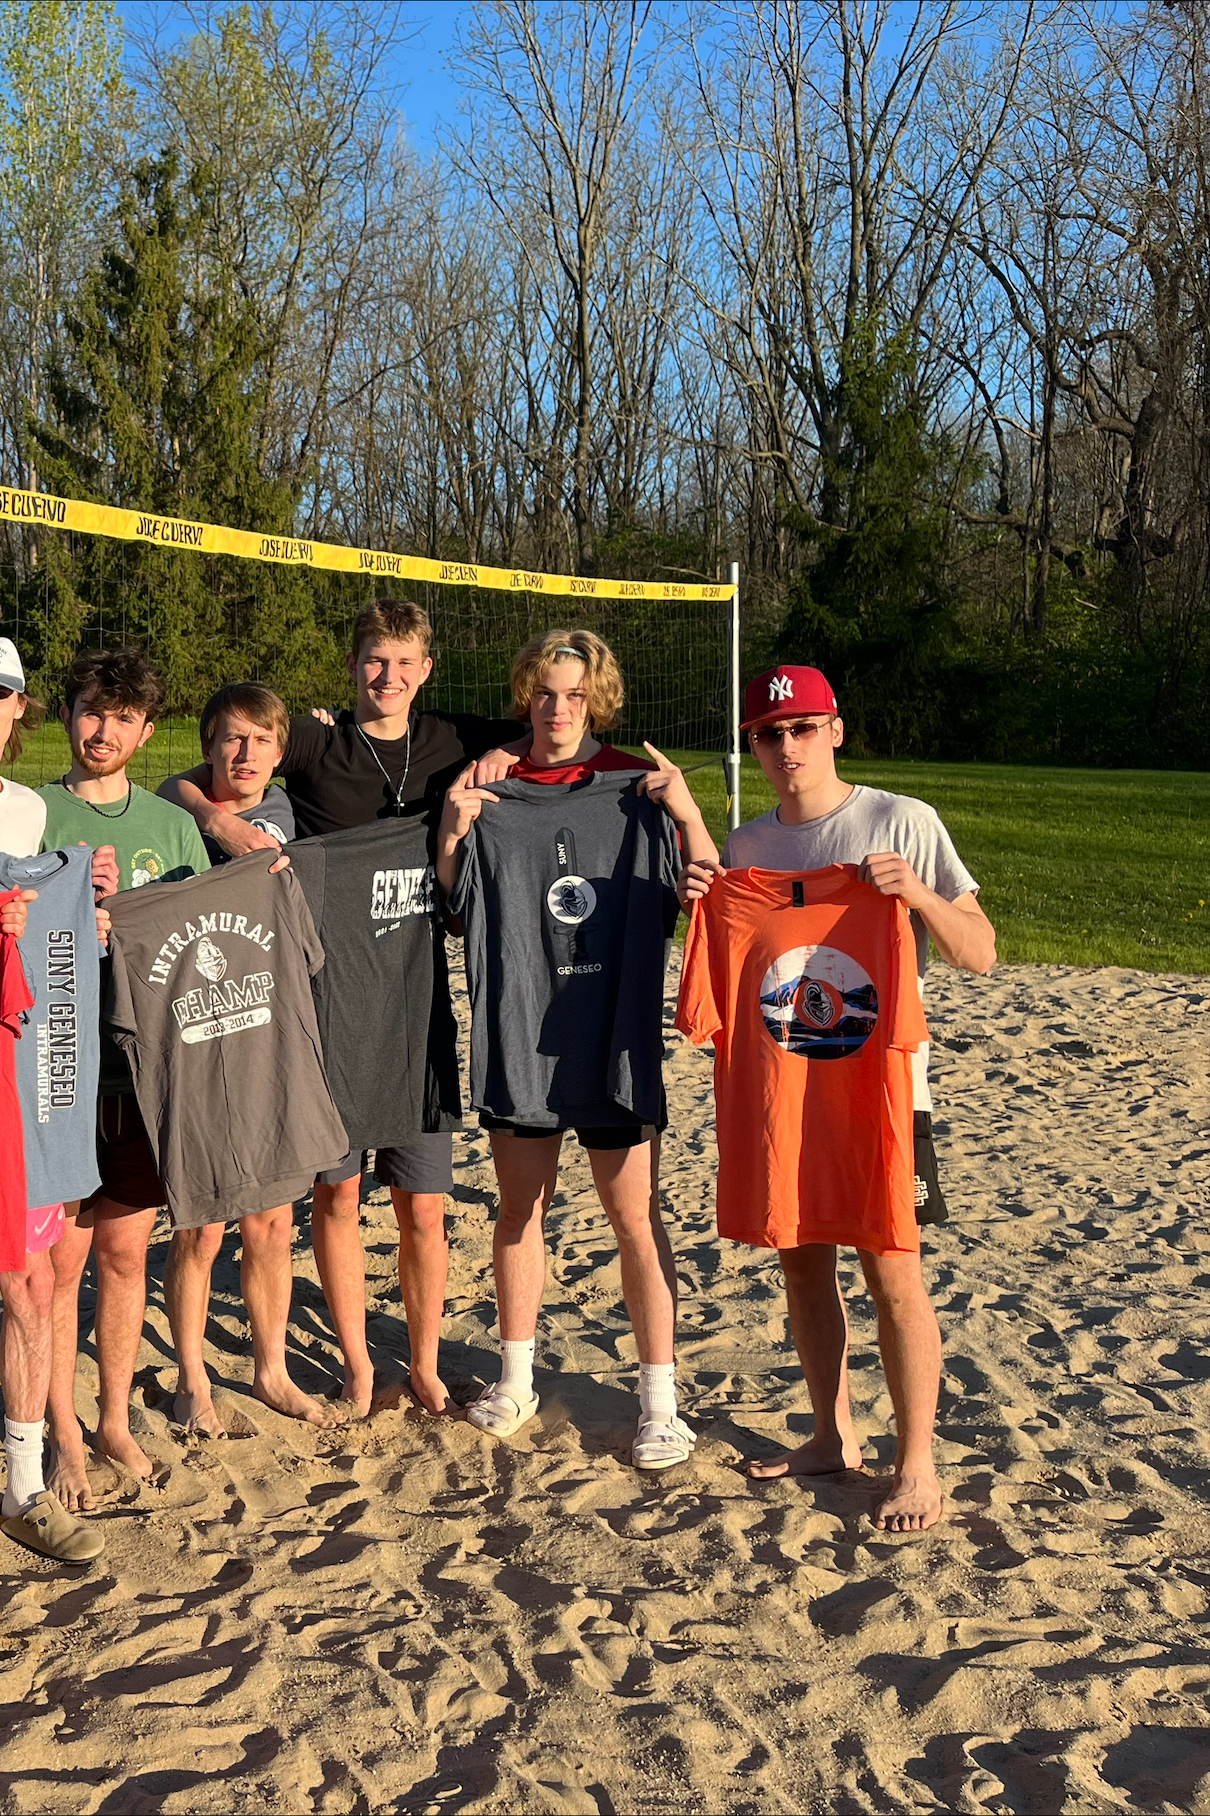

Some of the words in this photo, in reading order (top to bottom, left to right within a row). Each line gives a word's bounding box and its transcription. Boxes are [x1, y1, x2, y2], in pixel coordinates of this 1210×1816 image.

[768, 674, 794, 701] NY
[556, 842, 567, 865] SUNY
[46, 929, 77, 996] SUNY
[148, 912, 276, 985] INTRAMURAL
[557, 963, 602, 976] GENESEO
[172, 971, 275, 1029] CHAMP
[36, 1023, 50, 1124] INTRAMURALS
[47, 1001, 77, 1109] GENESEO
